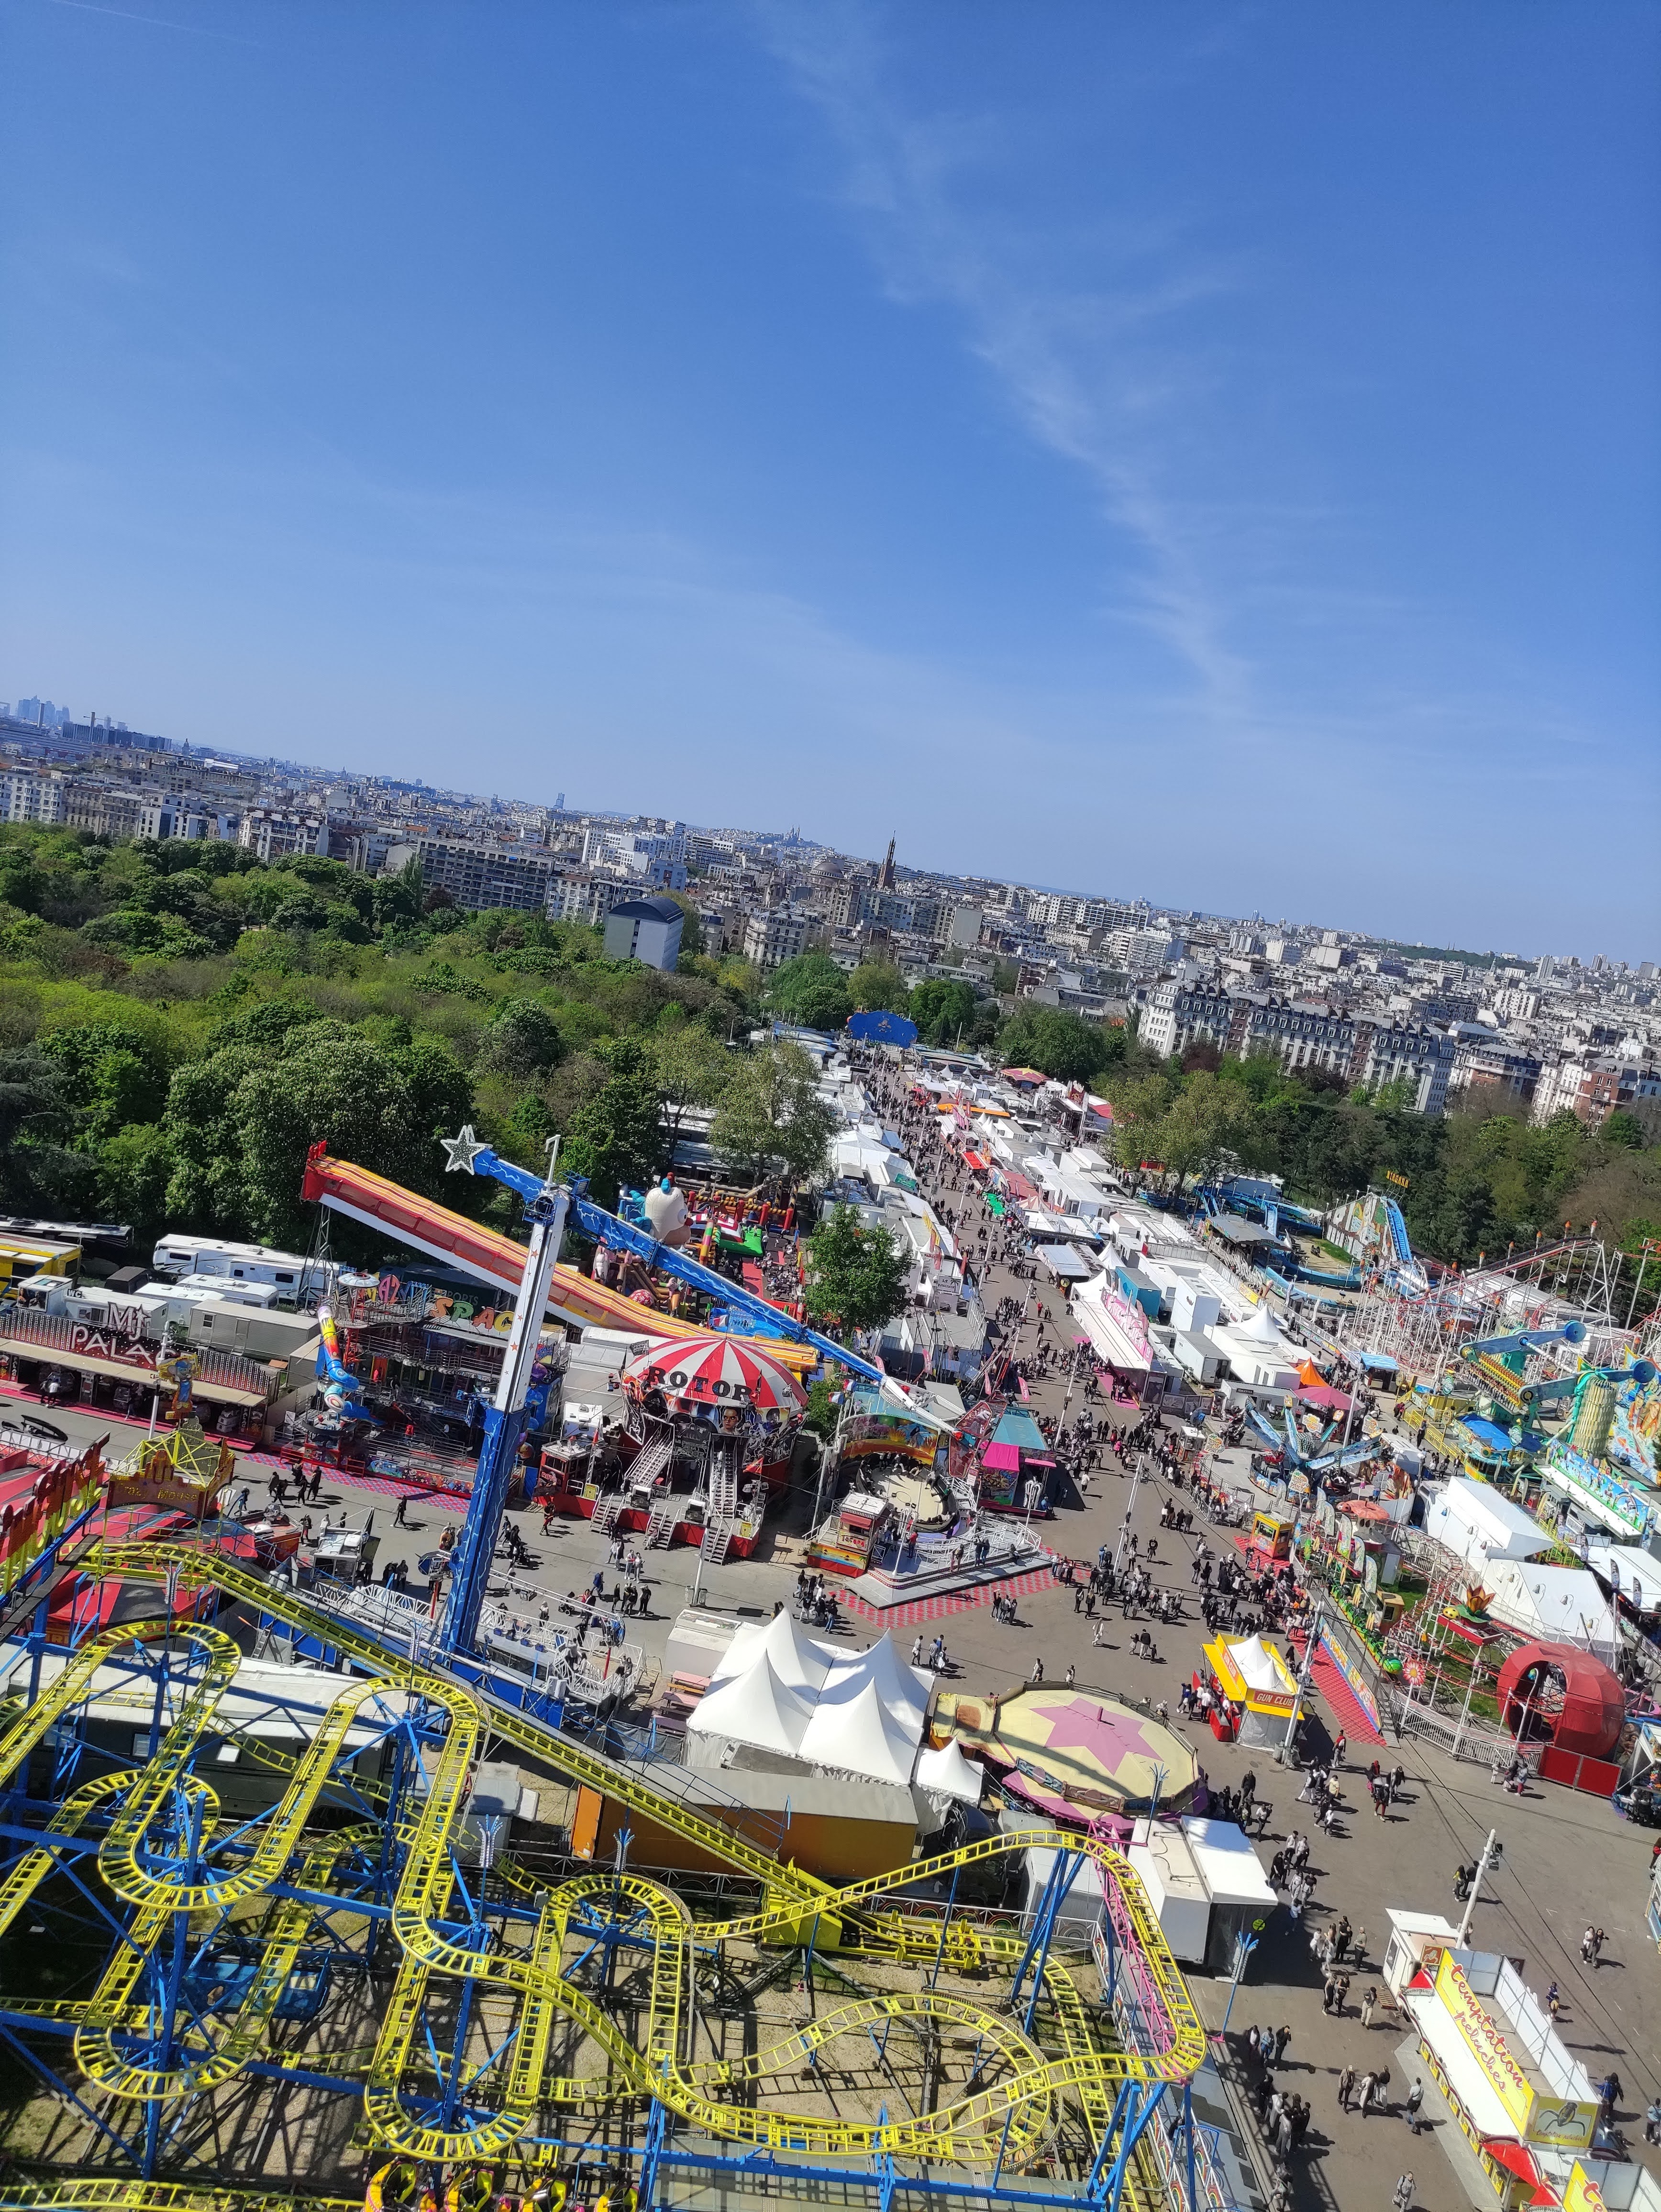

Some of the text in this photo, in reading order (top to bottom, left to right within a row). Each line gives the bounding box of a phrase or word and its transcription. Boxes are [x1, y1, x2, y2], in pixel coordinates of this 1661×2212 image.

[430, 1296, 514, 1332] SPAC
[71, 1324, 198, 1366] PALAC
[647, 1366, 752, 1401] ROTOR
[157, 1488, 198, 1501] Mouse
[1257, 1693, 1294, 1707] GUN CLUB
[1451, 1963, 1523, 2089] temptation
[1453, 2009, 1506, 2093] peluches
